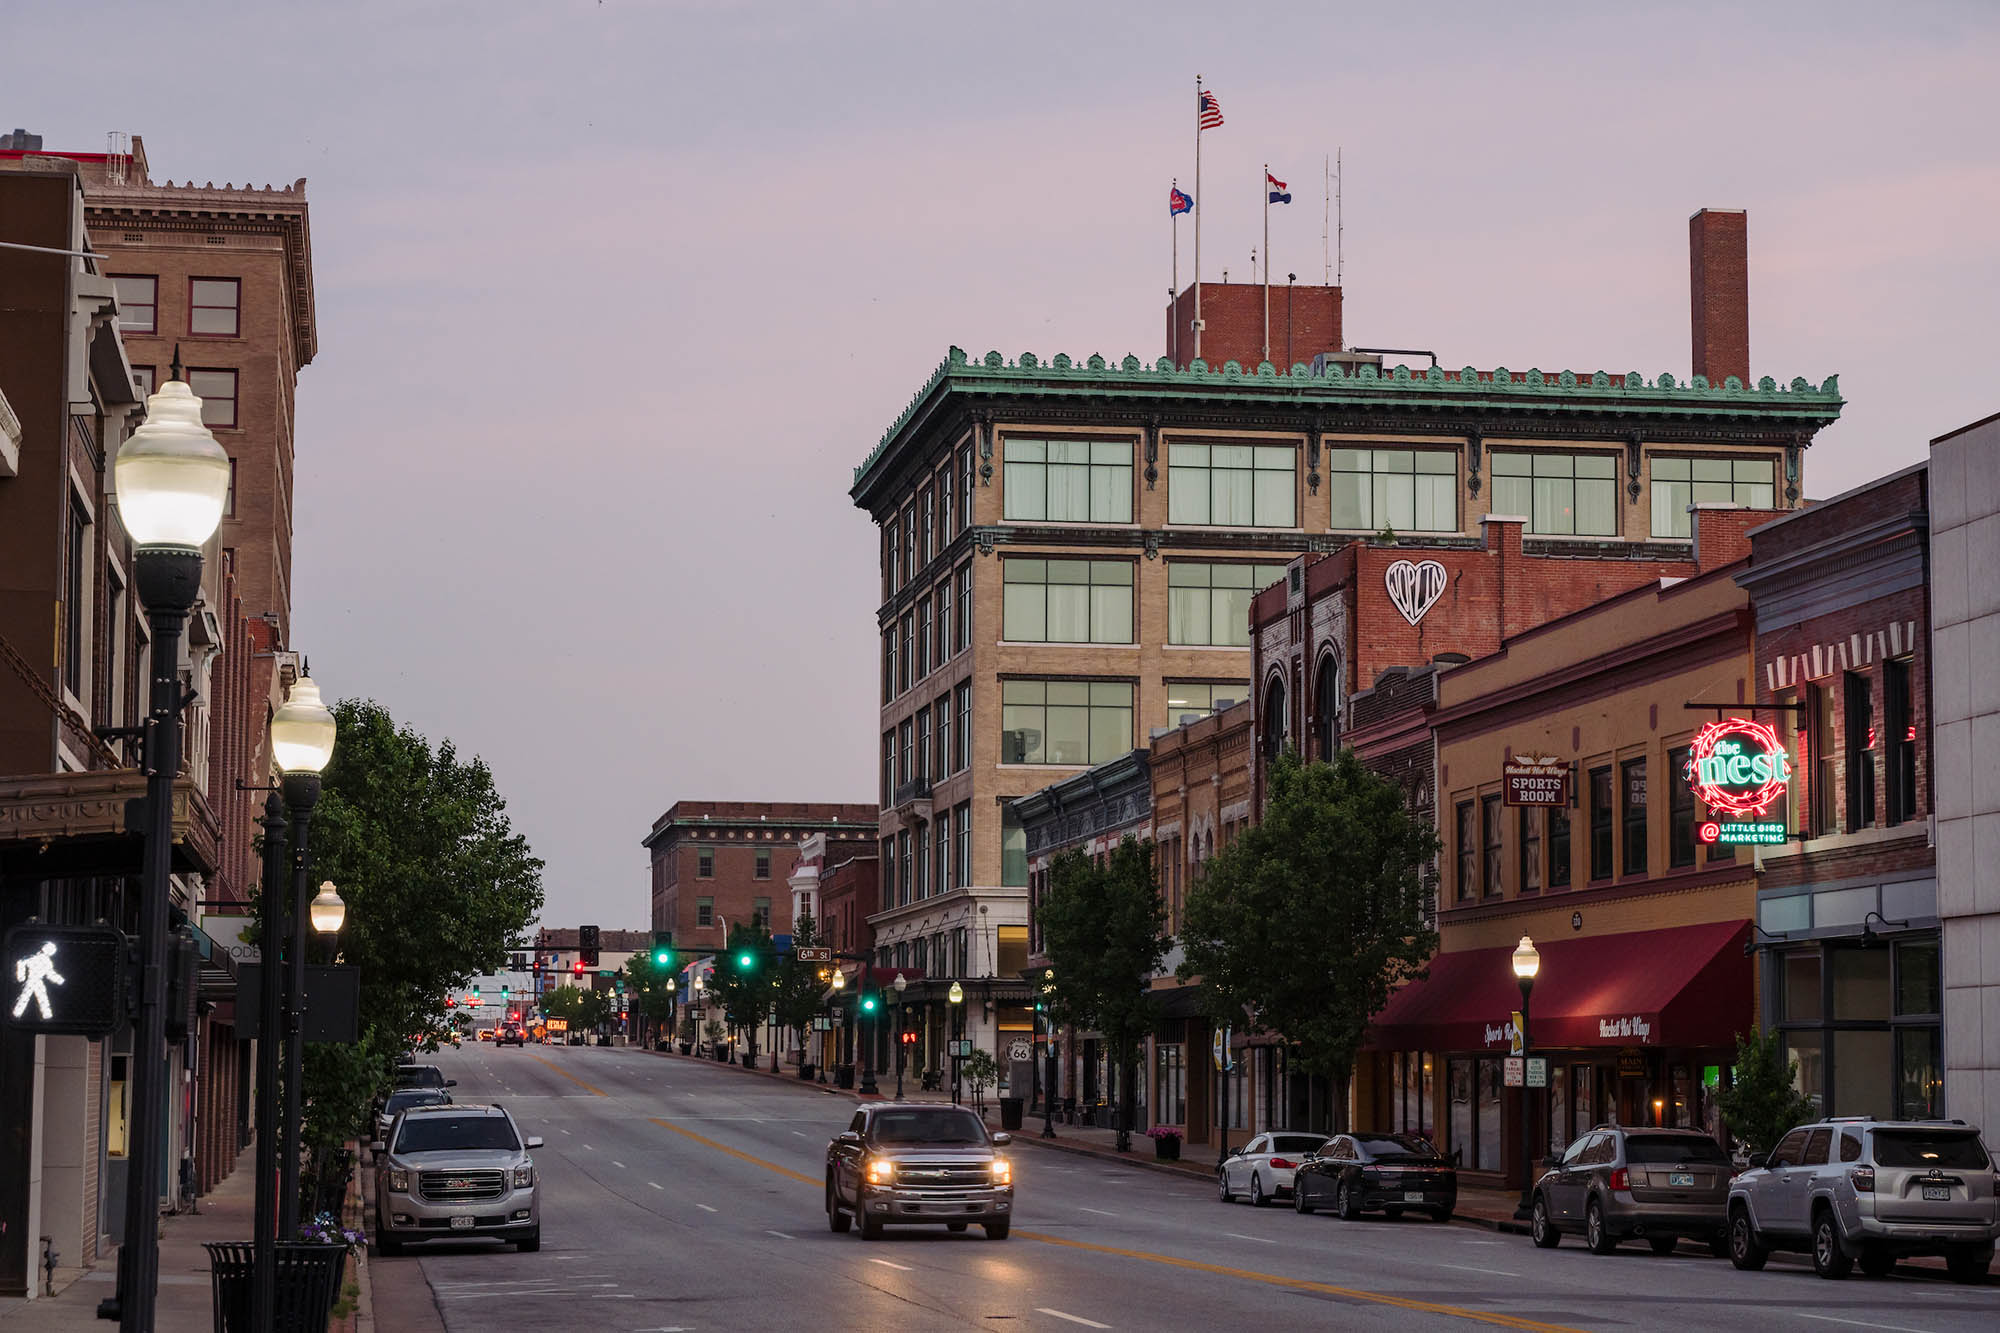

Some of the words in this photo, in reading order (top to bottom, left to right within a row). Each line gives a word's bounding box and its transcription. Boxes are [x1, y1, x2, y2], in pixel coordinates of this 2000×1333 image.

[1389, 563, 1444, 619] JOPLIN
[1714, 740, 1741, 755] the
[1698, 748, 1792, 786] nest
[1512, 778, 1561, 790] SPORTS
[1520, 790, 1556, 802] ROOM
[1701, 823, 1720, 842] @
[1720, 823, 1756, 833] LITTLE
[1757, 824, 1784, 833] BIRD
[1720, 834, 1784, 843] MARKETING
[800, 950, 814, 959] 6th
[1013, 1048, 1027, 1059] 66
